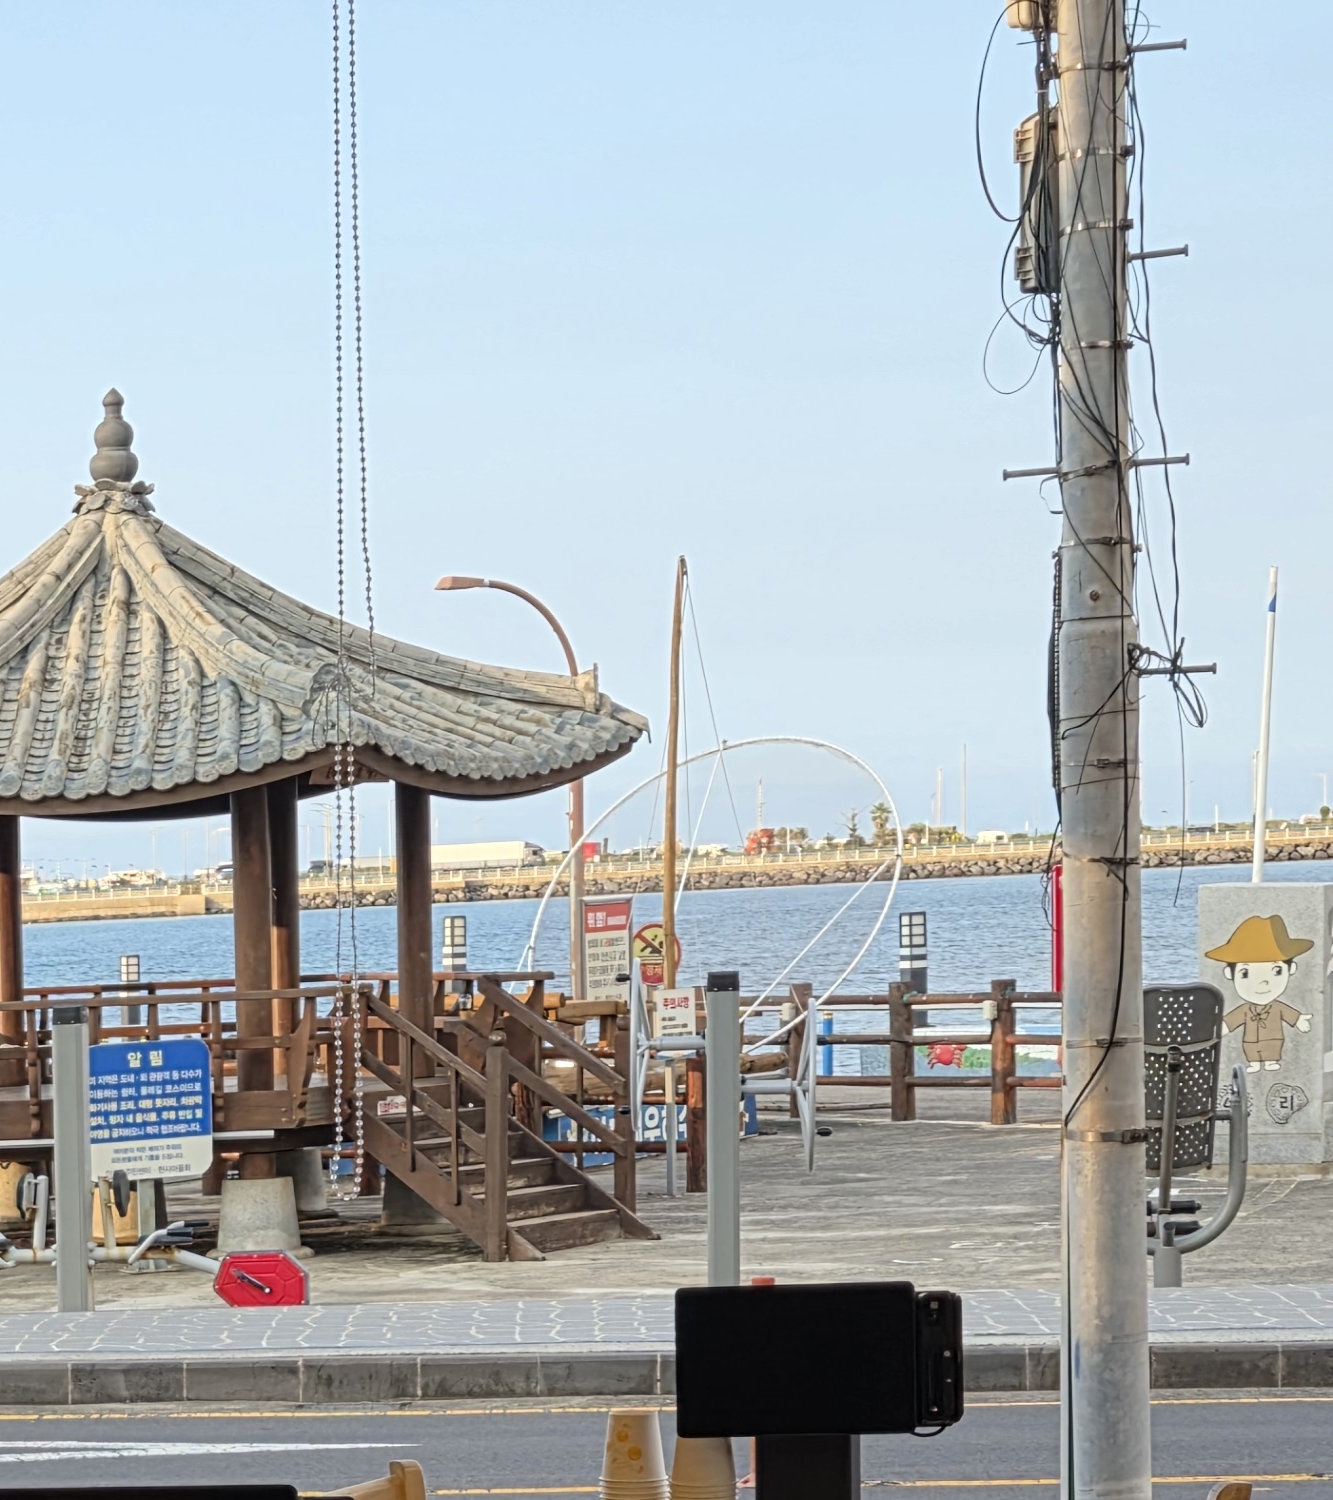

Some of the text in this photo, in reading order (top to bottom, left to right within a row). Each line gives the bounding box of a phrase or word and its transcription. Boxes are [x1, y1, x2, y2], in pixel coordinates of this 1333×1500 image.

[181, 1069, 203, 1079] 다수가
[89, 1089, 118, 1100] 이용하는
[165, 1082, 202, 1093] 코스이므로
